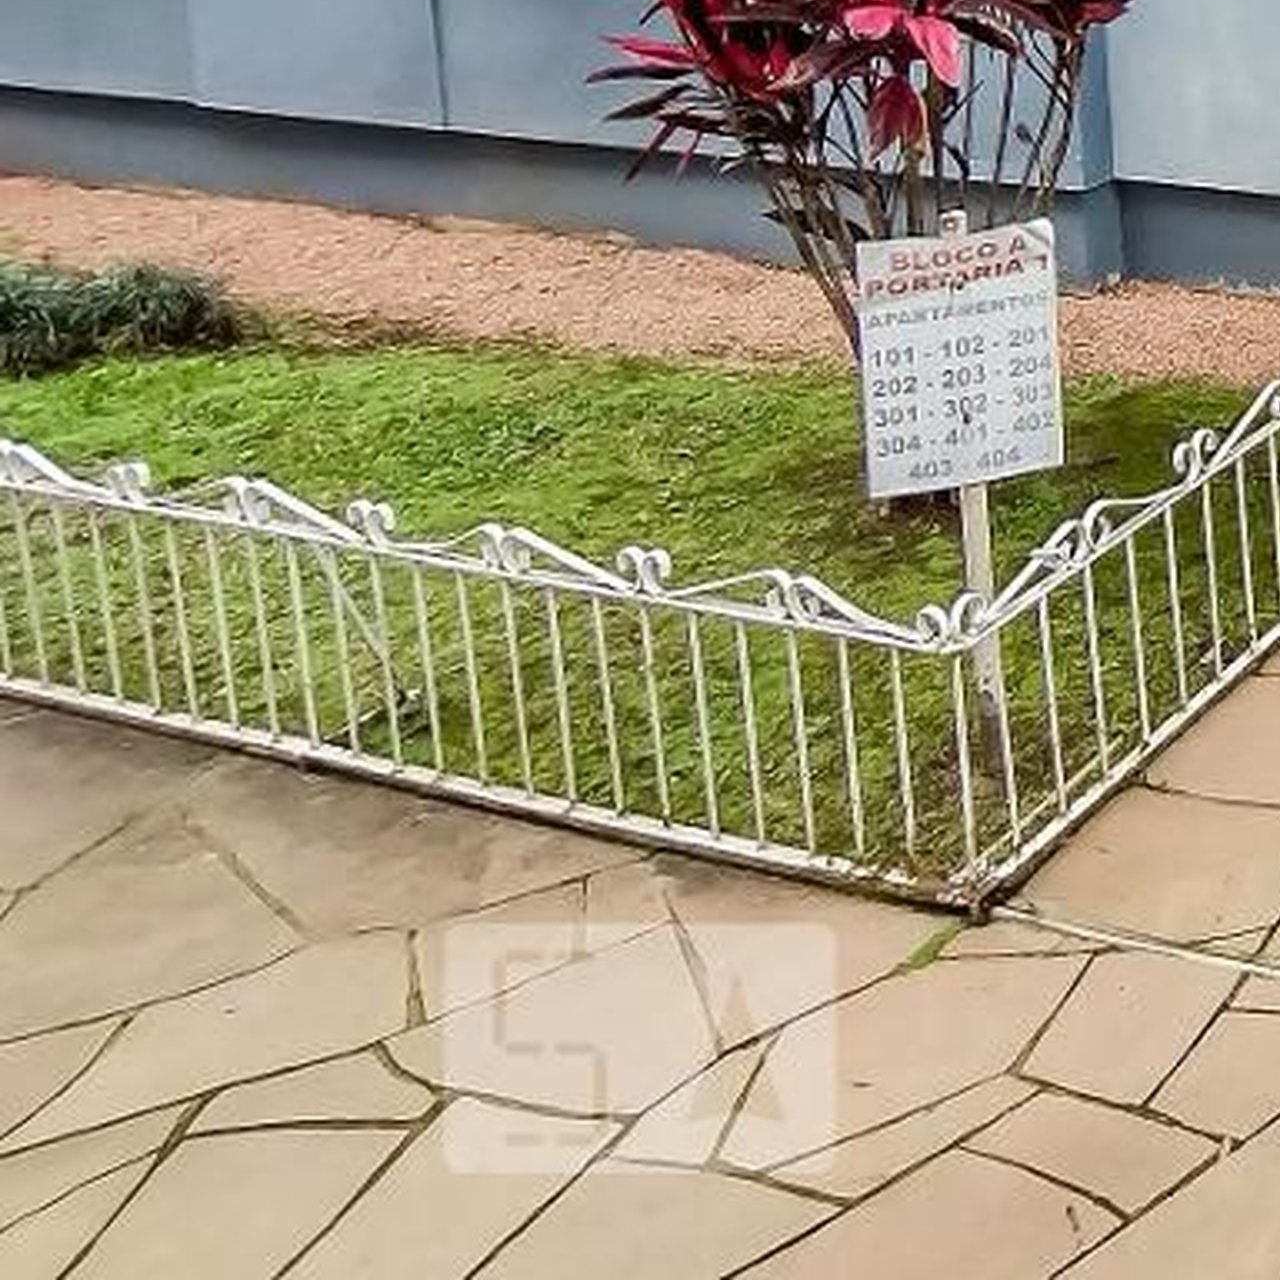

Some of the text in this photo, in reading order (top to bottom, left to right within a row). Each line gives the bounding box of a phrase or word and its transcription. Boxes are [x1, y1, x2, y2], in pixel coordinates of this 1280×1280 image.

[890, 234, 1026, 269] BLOCO A
[865, 259, 1025, 297] PORTARIA
[872, 346, 914, 368] 101
[940, 335, 984, 358] 102
[1008, 326, 1049, 348] 201
[872, 376, 917, 398] 202
[941, 364, 986, 389] 203
[1009, 353, 1051, 378] 204
[873, 406, 918, 428] 301
[942, 393, 987, 418] 302
[876, 435, 921, 458] 304
[944, 423, 988, 446] 401
[1012, 410, 1054, 434] 402
